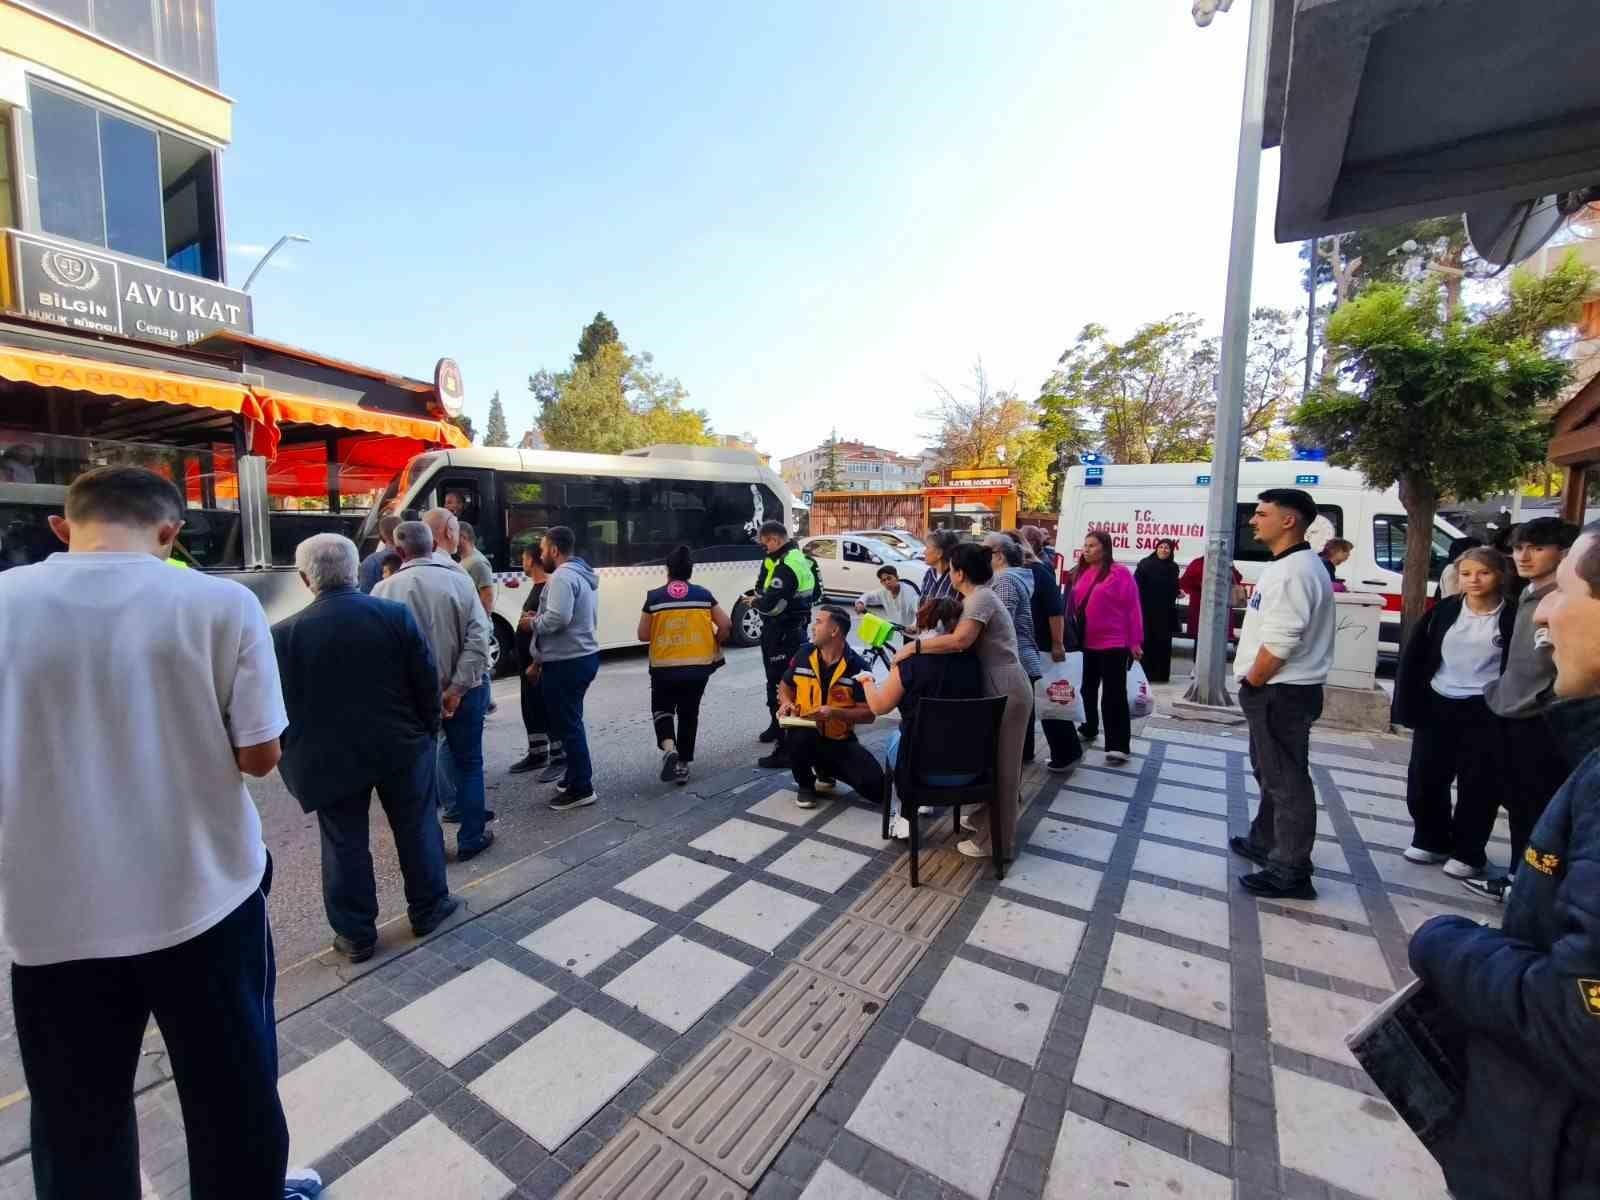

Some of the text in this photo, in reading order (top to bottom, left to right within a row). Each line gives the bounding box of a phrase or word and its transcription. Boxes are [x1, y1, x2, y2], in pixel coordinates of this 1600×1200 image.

[39, 291, 108, 318] BİLGİN
[125, 281, 241, 325] AVUKAT
[136, 319, 178, 341] Cenap
[1134, 510, 1155, 522] T.C.
[1087, 521, 1204, 537] SAĞLIK BAKANLIĞI
